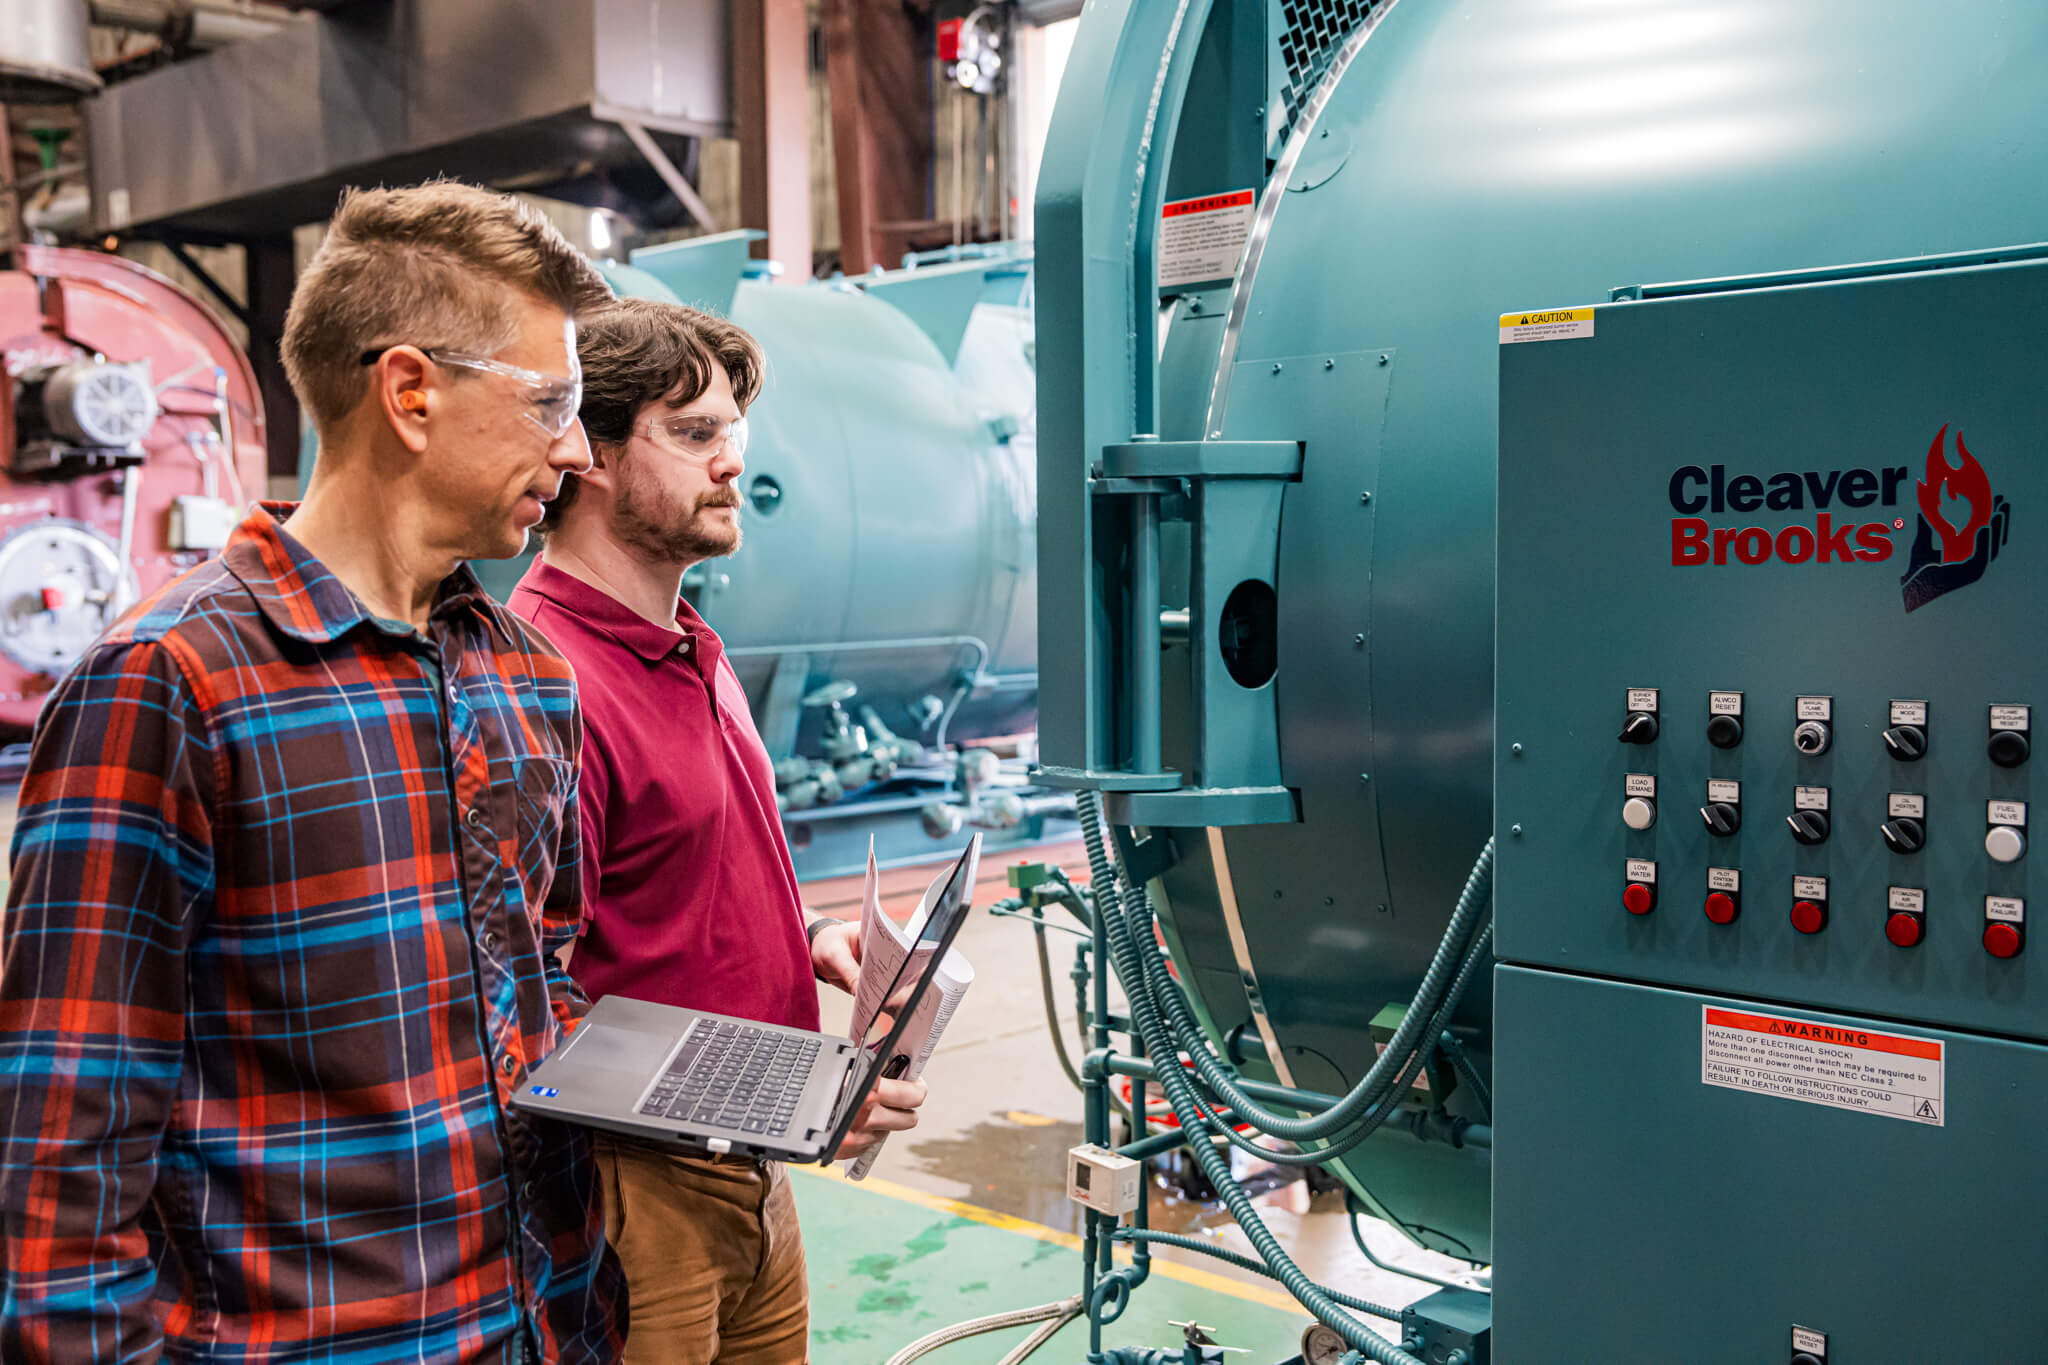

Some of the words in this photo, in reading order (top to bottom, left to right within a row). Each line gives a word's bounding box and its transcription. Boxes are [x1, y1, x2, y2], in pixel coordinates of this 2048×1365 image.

[1182, 195, 1239, 212] WARNING
[1531, 311, 1573, 324] CAUTION
[1668, 464, 1908, 514] Cleaver
[1671, 512, 1894, 566] Brooks
[1628, 785, 1652, 793] DEMAND
[1993, 901, 2016, 909] FLAME
[1708, 1030, 1744, 1042] HAZARD
[1746, 1036, 1759, 1044] OF
[1760, 1038, 1815, 1054] ELECTRICAL
[1818, 1048, 1853, 1060] SHOCK!
[1784, 1022, 1868, 1045] WARNING
[1708, 1039, 1728, 1049] More
[1730, 1043, 1748, 1052] than
[1750, 1047, 1766, 1055] one
[1767, 1049, 1812, 1063] disconnect
[1815, 1057, 1841, 1067] switch
[1844, 1063, 1861, 1072] may
[1864, 1065, 1875, 1073] be
[1878, 1068, 1915, 1081] required
[1918, 1074, 1927, 1082] to
[1708, 1049, 1751, 1062] disconnect
[1753, 1055, 1763, 1064] all
[1765, 1059, 1790, 1069] power
[1793, 1062, 1814, 1072] other
[1817, 1067, 1836, 1077] than
[1838, 1070, 1858, 1080] NEC
[1860, 1074, 1885, 1086] Class
[1707, 1063, 1741, 1075] FAILURE
[1744, 1069, 1756, 1078] TO
[1757, 1071, 1792, 1084] FOLLOW
[1794, 1078, 1858, 1095] INSTRUCTIONS
[1860, 1089, 1892, 1102] COULD
[1707, 1071, 1739, 1084] RESULT
[1741, 1077, 1750, 1086] IN
[1752, 1079, 1780, 1091] DEATH
[1782, 1085, 1794, 1094] OR
[1796, 1087, 1835, 1101] SERIOUS
[1799, 1340, 1818, 1349] RESET
